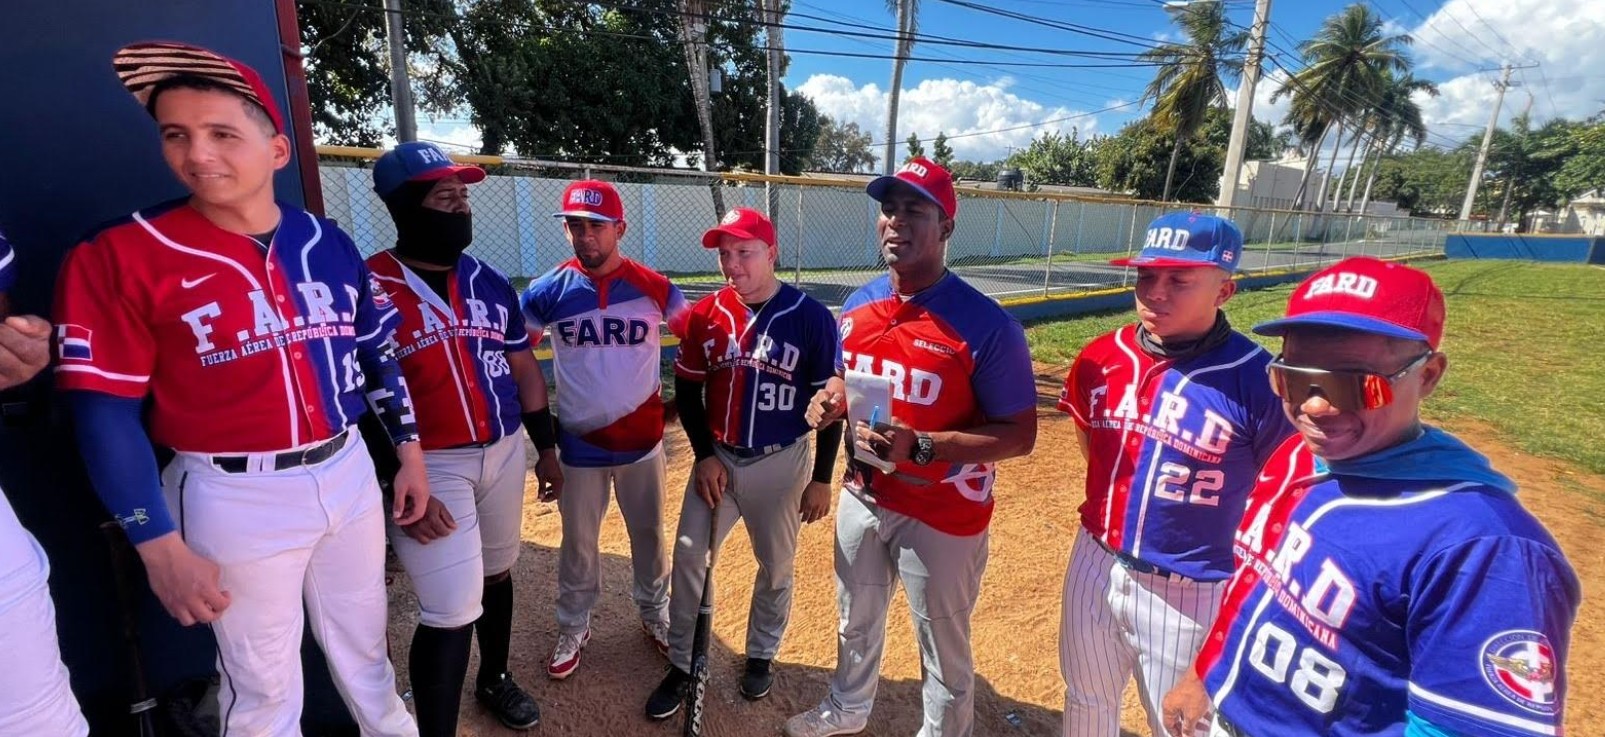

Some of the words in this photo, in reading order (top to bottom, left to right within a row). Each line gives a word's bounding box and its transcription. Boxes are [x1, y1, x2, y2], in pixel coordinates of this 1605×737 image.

[569, 188, 603, 207] FARD
[1304, 272, 1379, 299] FARD
[200, 349, 238, 367] FUERZA
[241, 341, 273, 357] AÉREA
[290, 326, 339, 342] REPÚBLICA
[556, 316, 649, 348] FARD
[757, 382, 797, 411] 30
[1089, 384, 1233, 454] F.A.R.D
[1154, 461, 1225, 506] 22
[1278, 589, 1339, 650] DOMINICANA
[1249, 621, 1346, 713] 08
